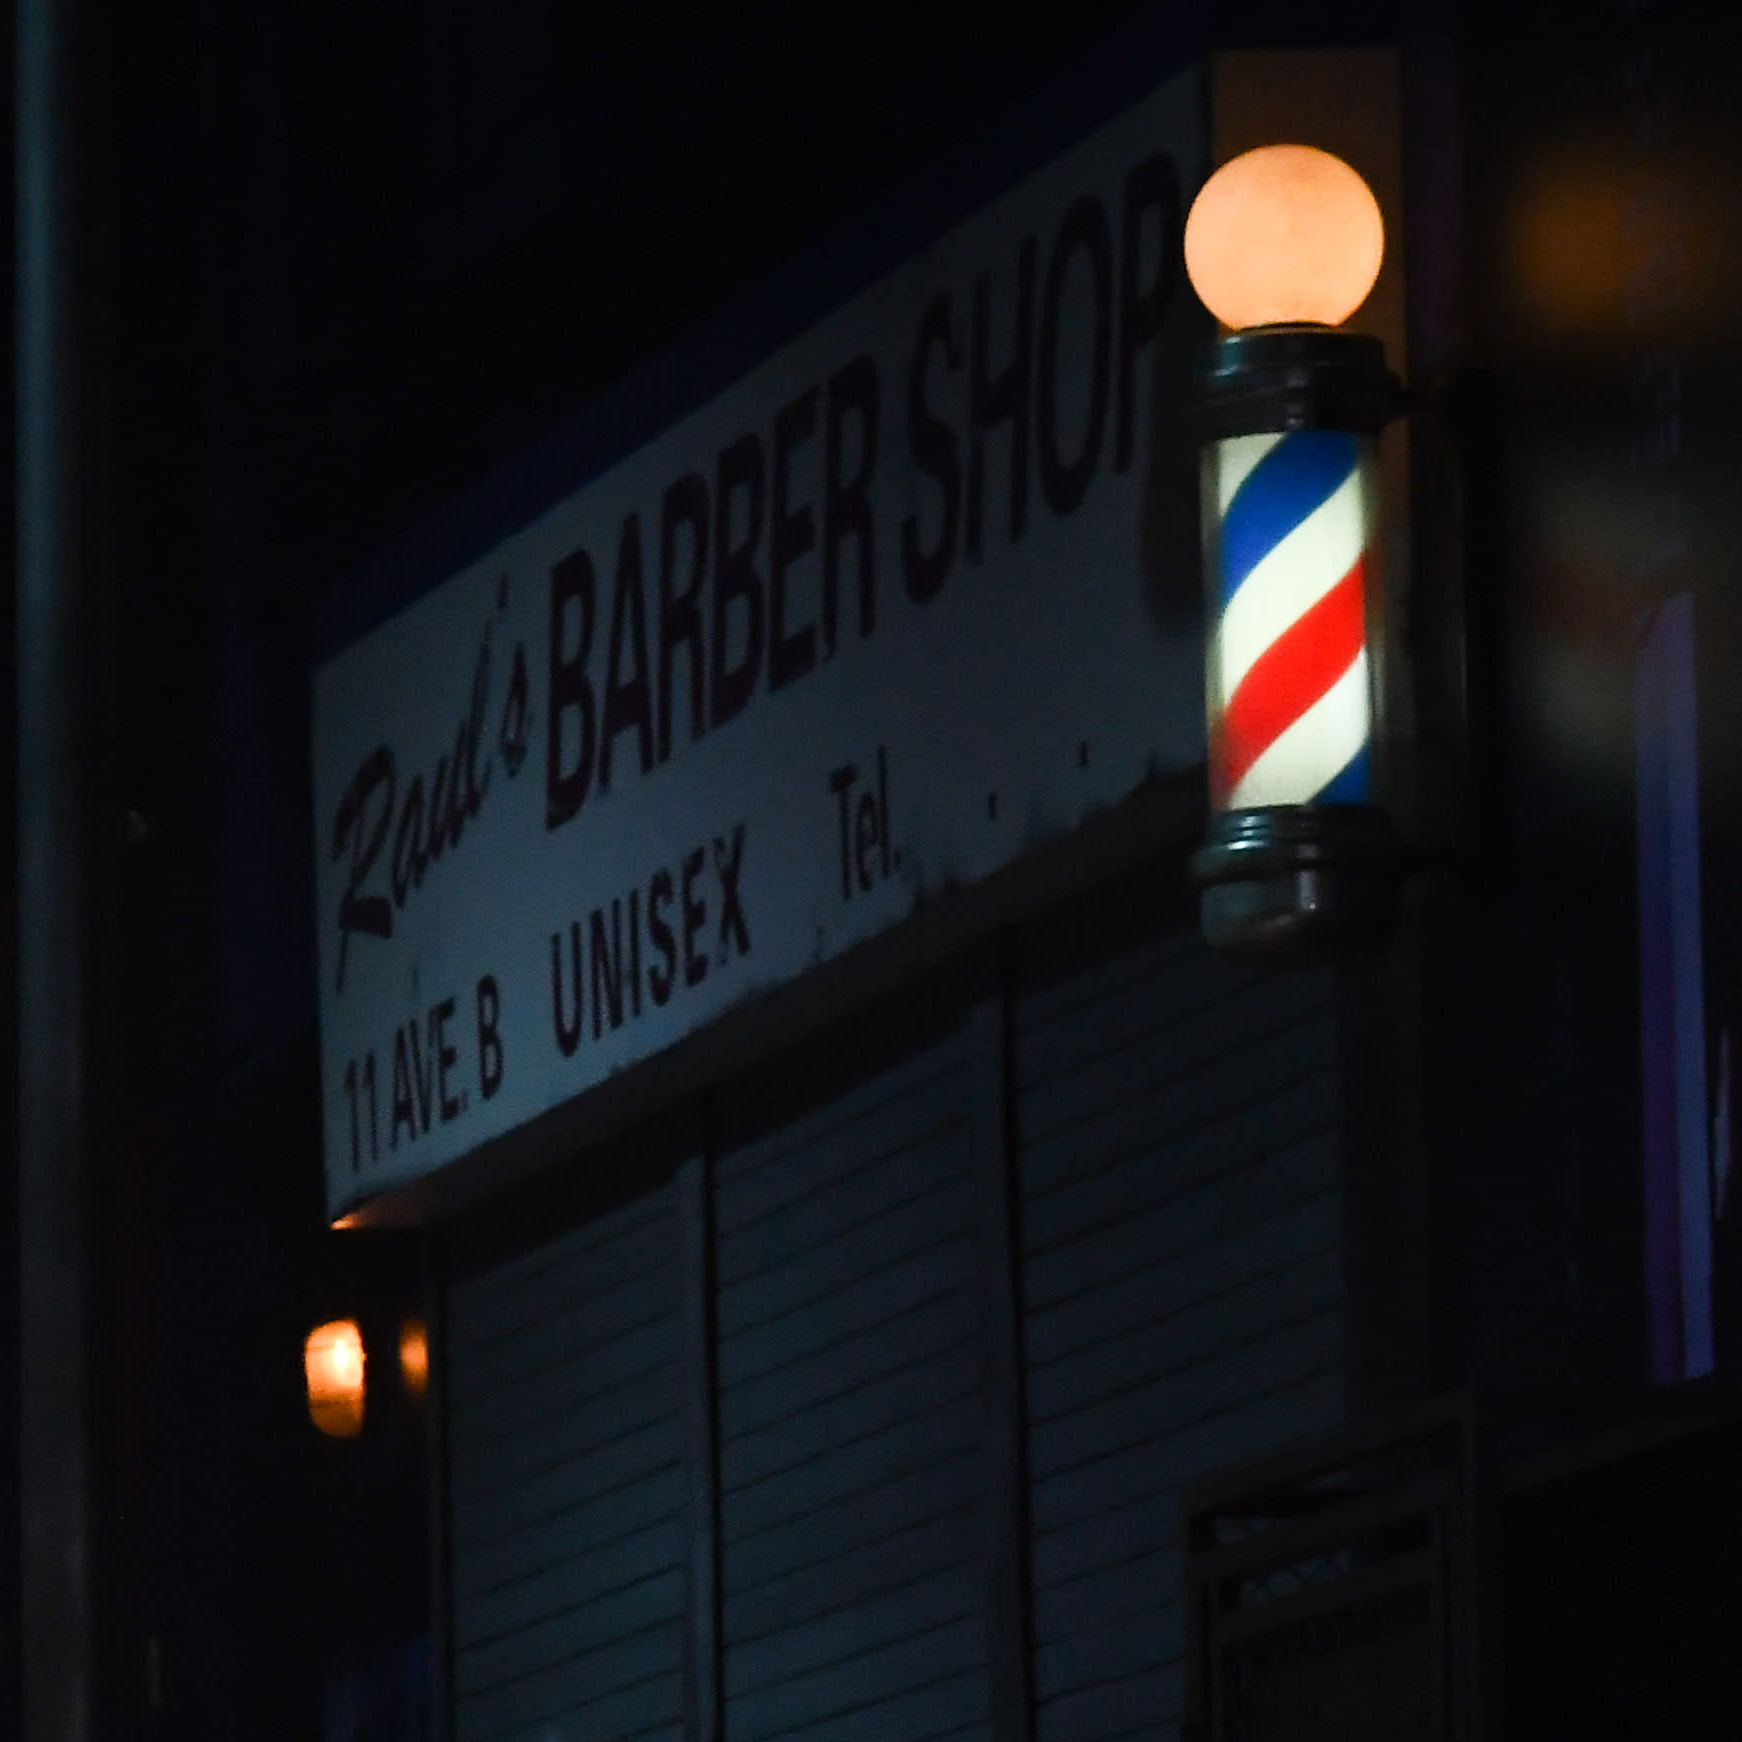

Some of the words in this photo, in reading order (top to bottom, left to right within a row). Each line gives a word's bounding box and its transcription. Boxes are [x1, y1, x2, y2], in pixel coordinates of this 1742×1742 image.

[331, 572, 531, 993] Raul's
[546, 353, 878, 831] BARBER
[902, 152, 1180, 603] SHOP
[345, 1048, 378, 1173] 11
[477, 975, 504, 1101] B
[550, 823, 750, 1058] UNISEX
[829, 743, 901, 902] Tel.
